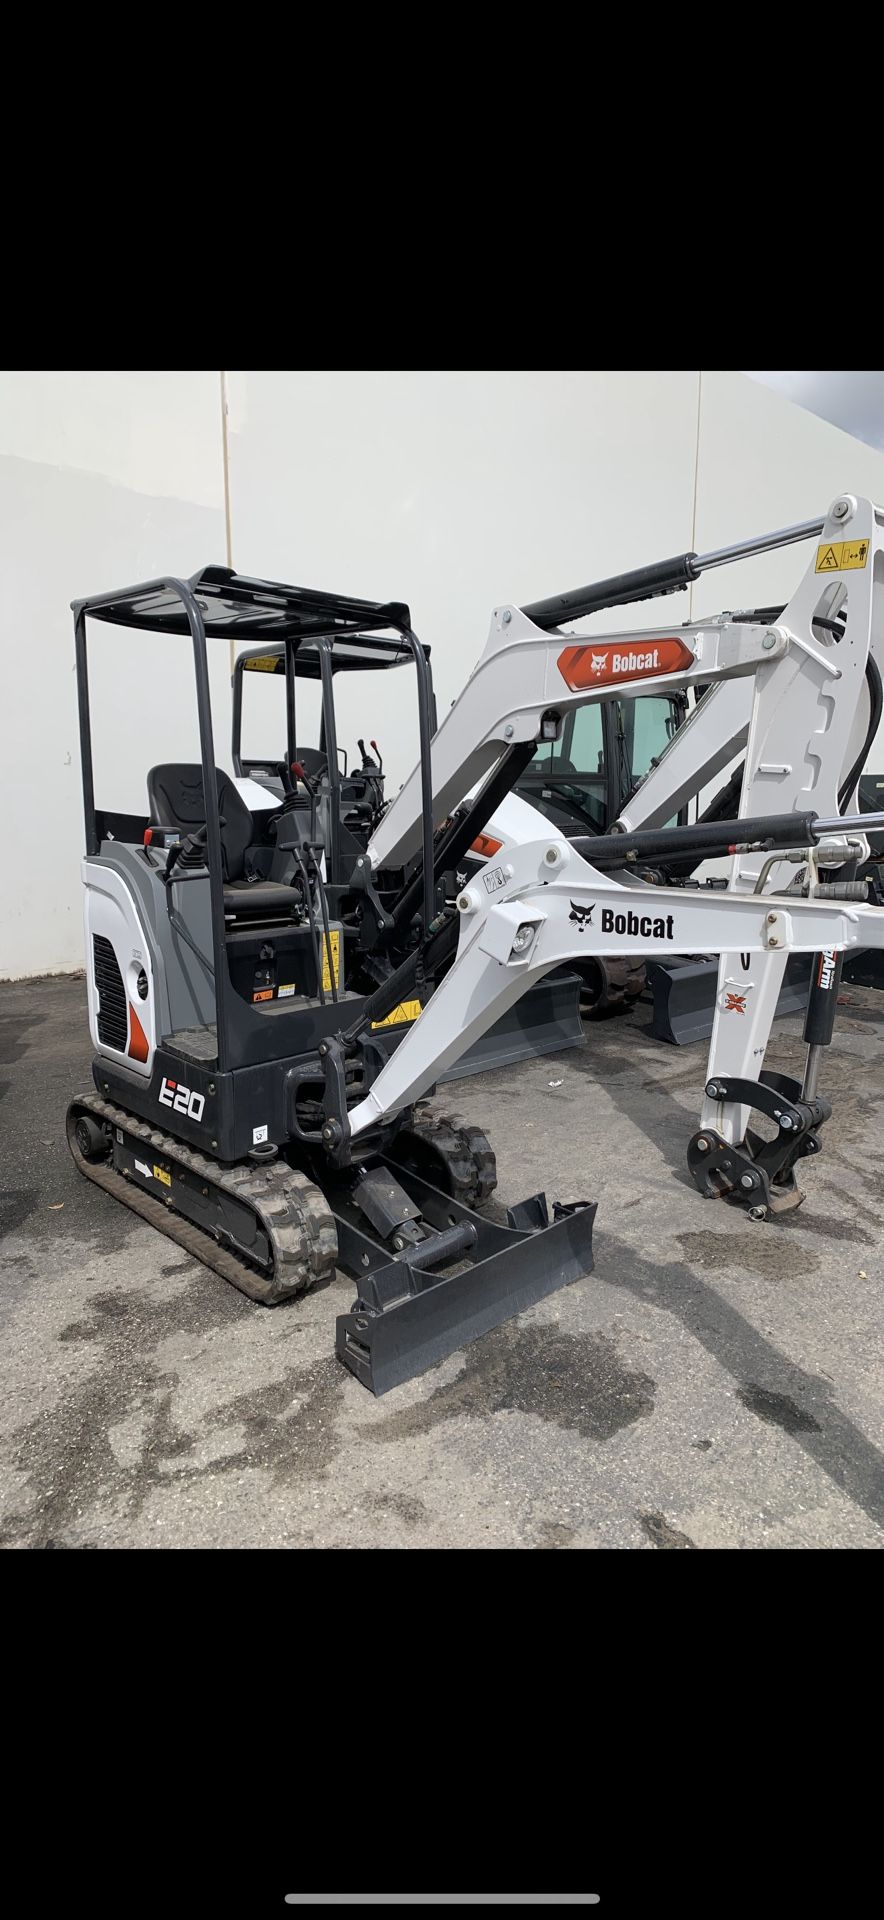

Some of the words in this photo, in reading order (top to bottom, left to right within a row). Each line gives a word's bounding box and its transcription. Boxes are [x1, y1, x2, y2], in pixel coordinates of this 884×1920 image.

[612, 649, 659, 673] Bobcat
[601, 908, 674, 940] Bobcat
[158, 1077, 206, 1123] E20
